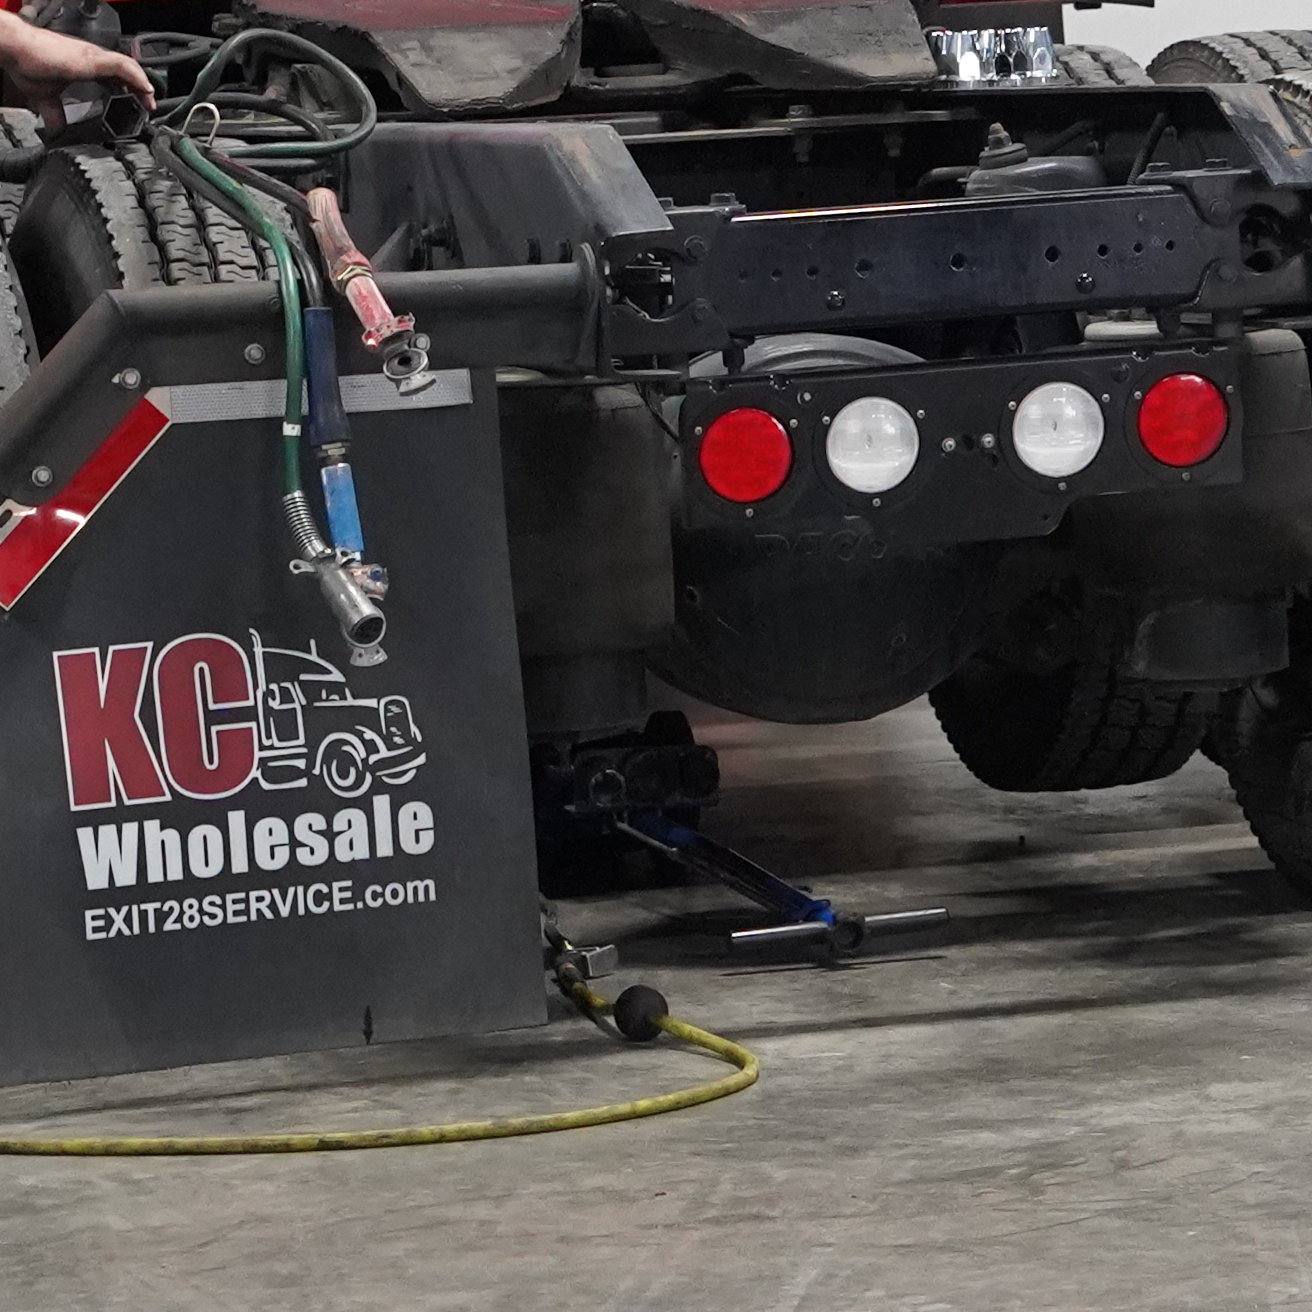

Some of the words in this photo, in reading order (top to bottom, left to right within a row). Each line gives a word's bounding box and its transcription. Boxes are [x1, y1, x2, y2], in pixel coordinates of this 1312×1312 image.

[52, 633, 259, 811] KC
[76, 794, 435, 891] Wholesale
[84, 878, 436, 941] EXIT28SERVICE.com
